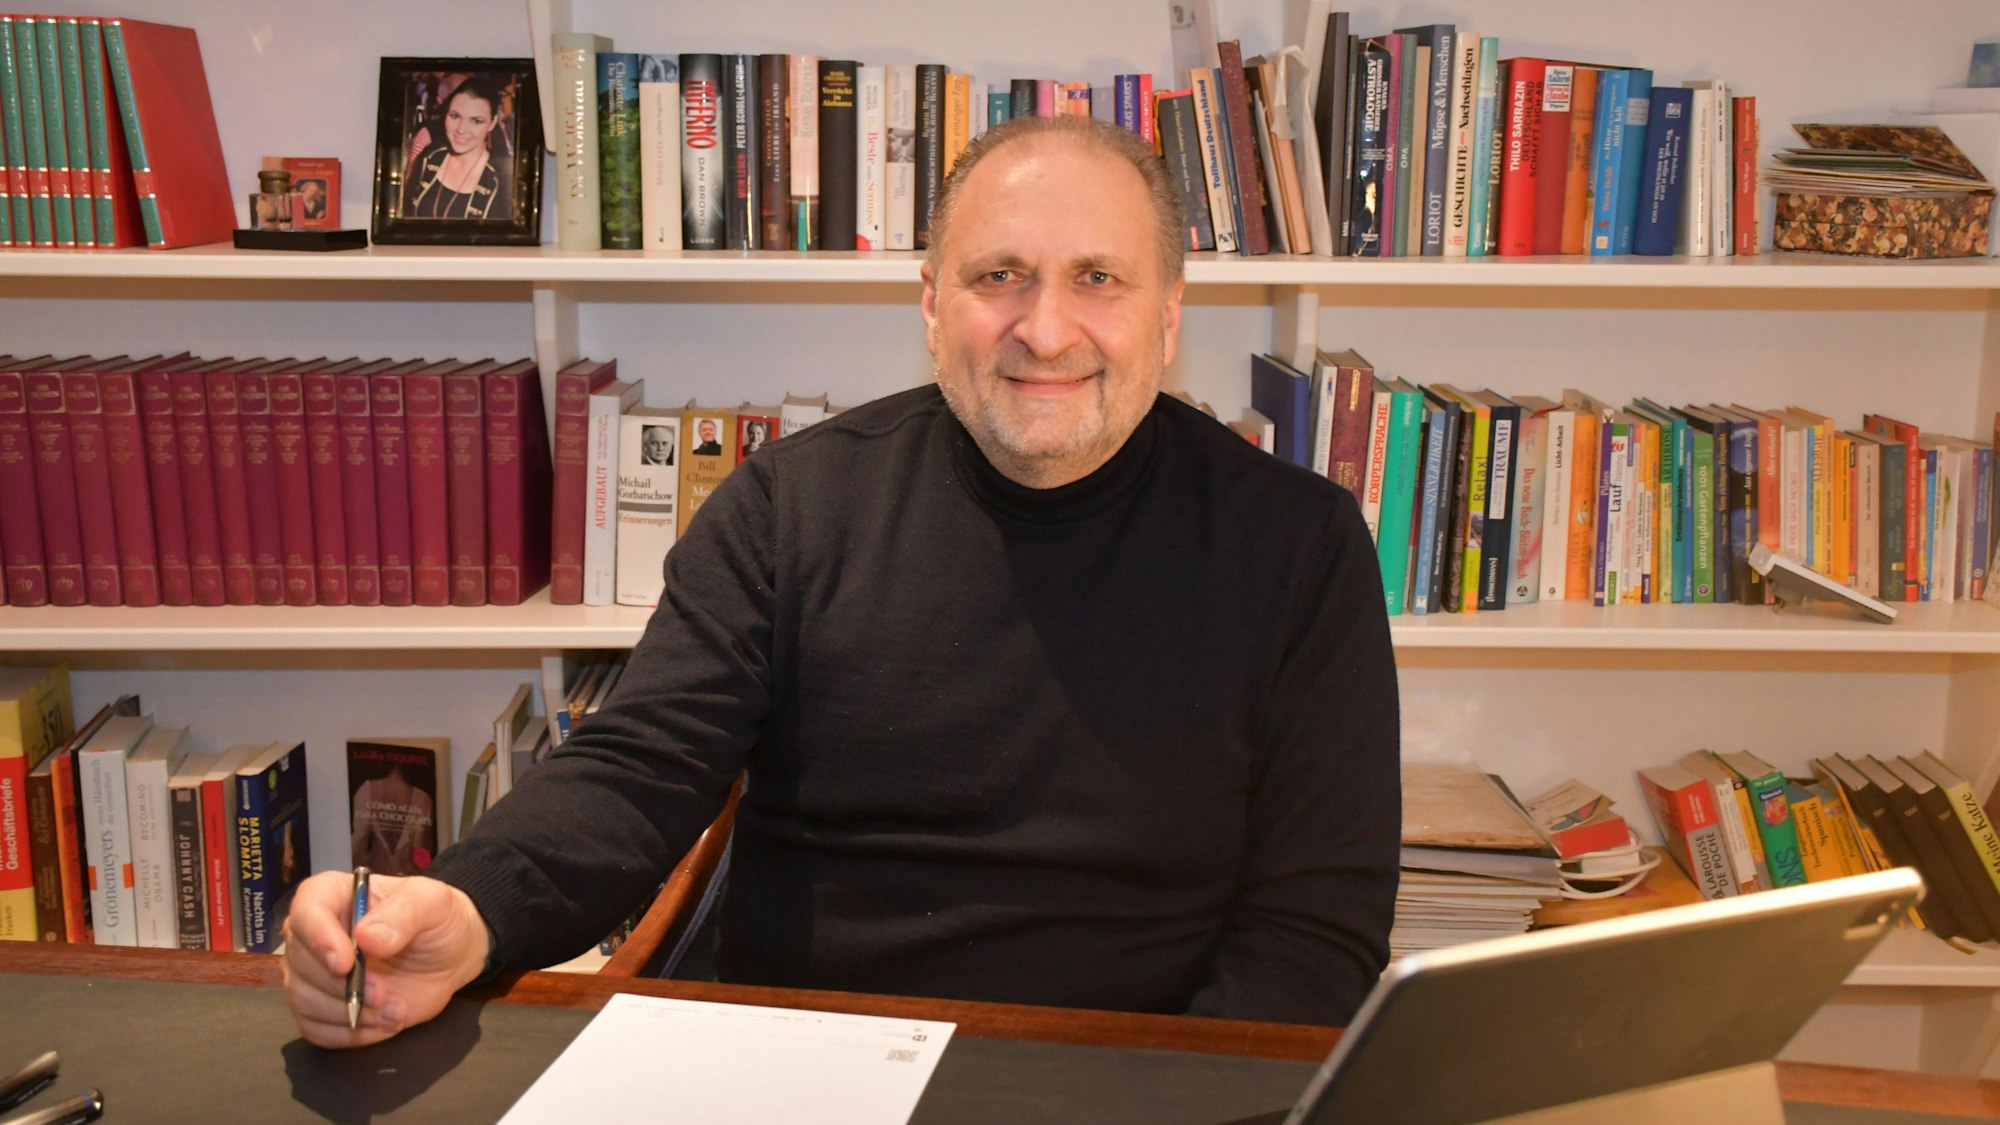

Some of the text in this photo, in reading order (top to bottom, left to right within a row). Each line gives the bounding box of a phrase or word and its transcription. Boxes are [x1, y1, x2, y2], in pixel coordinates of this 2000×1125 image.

[615, 61, 627, 137] Charlotte Link
[952, 79, 964, 96] Tag
[1123, 81, 1133, 109] SPARKS
[1364, 58, 1376, 132] ASTROLOGIE
[1376, 58, 1384, 90] GROSSER
[1431, 35, 1451, 150] Möpse & Menschen
[1458, 47, 1474, 130] Nachschlagen
[686, 80, 718, 150] INFERNO
[772, 82, 780, 119] IRLAND
[952, 98, 964, 136] einziger
[1521, 80, 1536, 162] DEUTSCHLAND
[1534, 103, 1542, 128] SICH
[736, 125, 746, 149] PETER
[772, 133, 780, 161] LIEBE
[867, 131, 878, 165] Beste
[1198, 79, 1221, 190] Tollhaus Deutschland
[1509, 80, 1526, 172] THILO SARRAZIN
[1603, 127, 1613, 151] Hitze
[1613, 105, 1623, 147] nicht kalt
[1489, 130, 1504, 185] LORIOT
[1529, 129, 1541, 178] SCHAFFT
[1453, 146, 1468, 228] GESCHICHTE
[1428, 191, 1442, 246] LORIOT
[698, 461, 715, 471] Bill
[1369, 403, 1388, 504] KÖRPERSPRACHE
[1425, 426, 1444, 506] SINNLICHKEIT
[1555, 425, 1564, 469] Licht-Arbeit
[1663, 429, 1672, 483] ARTHROSE
[1766, 425, 1778, 479] Alles erlaubt!
[1812, 437, 1823, 483] ALLERGIE
[595, 464, 608, 529] AUFGEBAUT
[618, 477, 651, 488] Michail
[618, 488, 673, 501] Gorbatschow
[1473, 455, 1488, 501] Relax!
[1522, 485, 1532, 504] neue
[1524, 468, 1535, 484] Das
[1600, 470, 1610, 496] Pilates
[1609, 482, 1623, 512] Lauf
[1744, 476, 1752, 490] Aus
[618, 513, 673, 528] Erinnerungen
[1698, 465, 1710, 569] 1001 Gartenpflanzen
[6, 777, 19, 872] Geschäftsbriefe
[137, 783, 151, 910] MICHELLE BECOMING
[238, 816, 252, 880] SLOMKA
[249, 816, 263, 881] MARIETTA
[1961, 792, 2000, 876] Meine Katze
[103, 830, 119, 928] Grönemeyers
[153, 863, 164, 903] OBAMA
[178, 833, 193, 883] JOHNNY
[1696, 834, 1718, 890] LAROUSSE
[1705, 831, 1729, 887] DE POCHE
[5, 905, 13, 937] Franken
[182, 883, 195, 919] CASH
[242, 887, 254, 947] Kanzleramt
[253, 890, 264, 944] Nachts im
